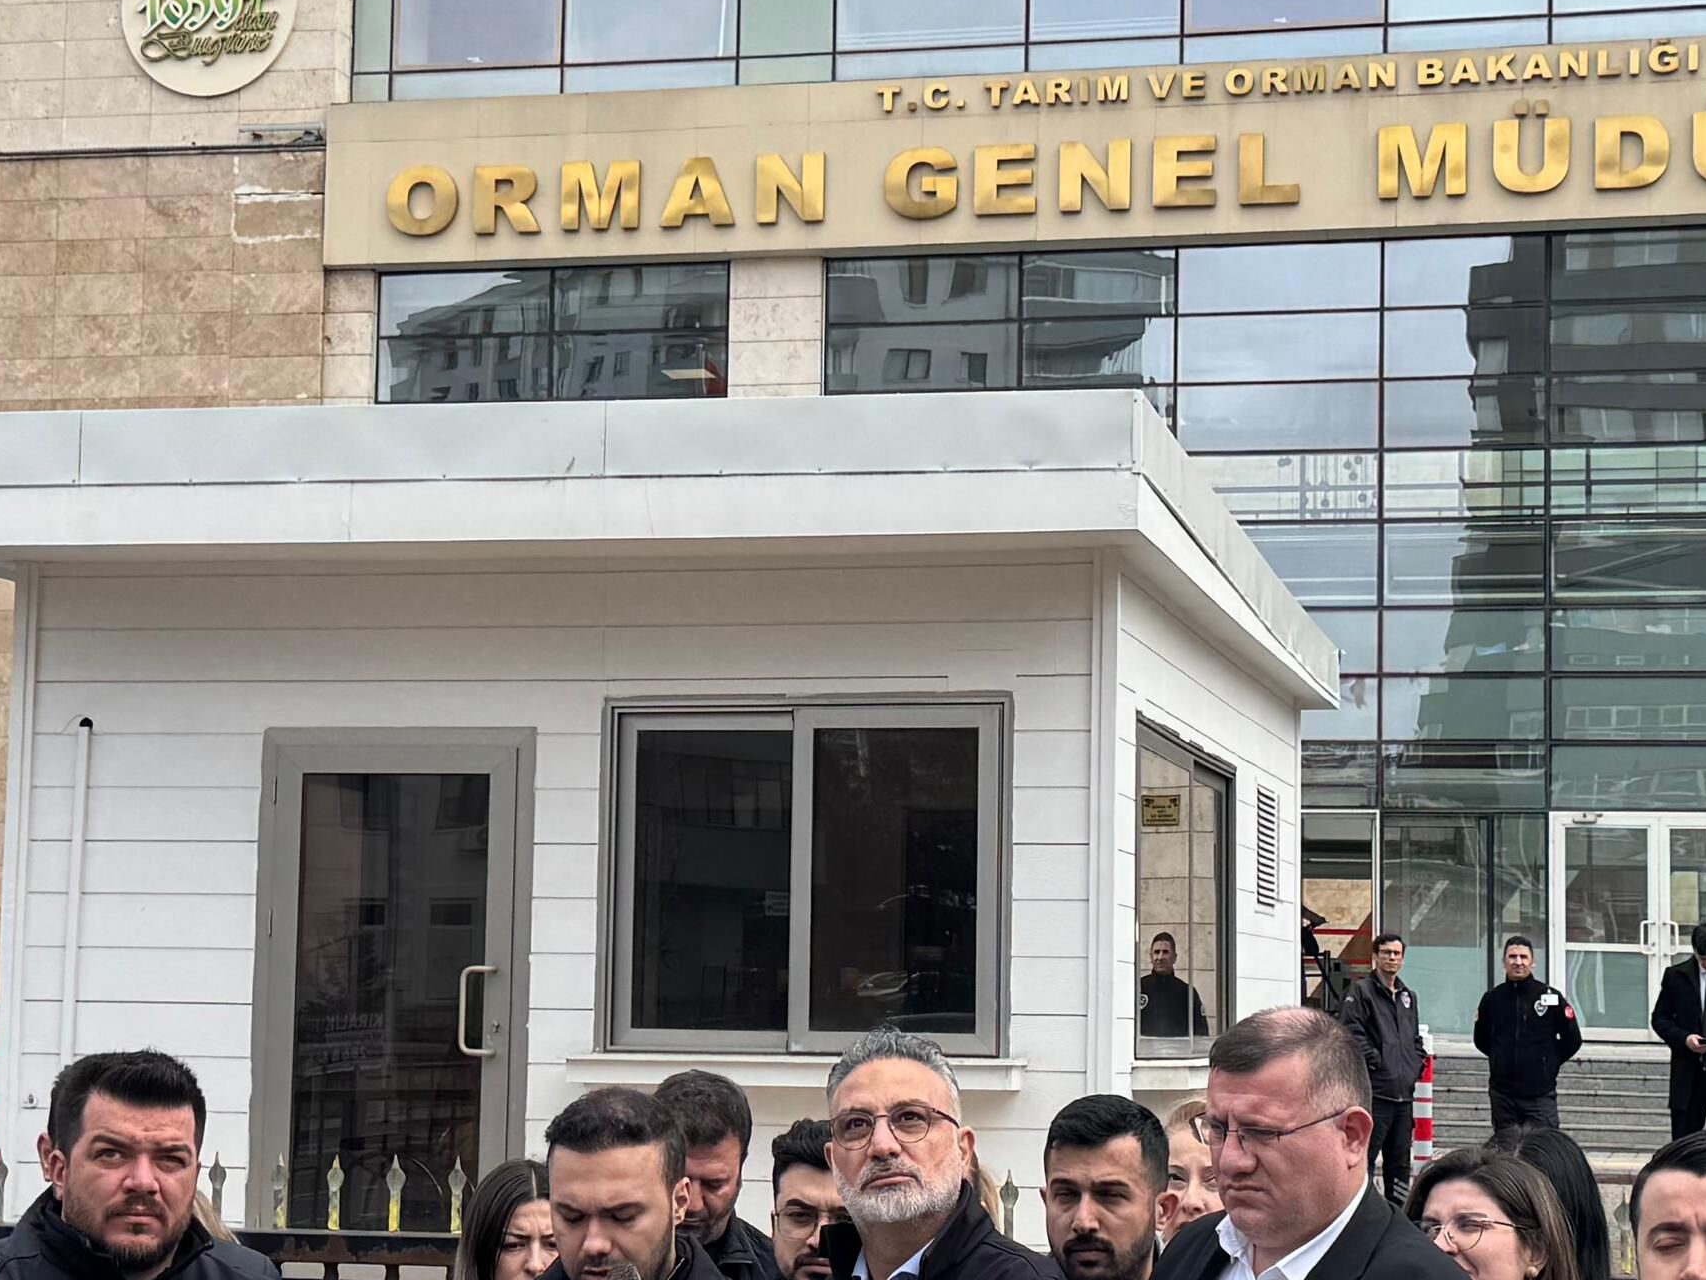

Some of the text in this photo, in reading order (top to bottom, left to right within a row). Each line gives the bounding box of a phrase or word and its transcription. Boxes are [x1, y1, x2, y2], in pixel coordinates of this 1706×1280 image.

[876, 38, 1700, 113] T.C. TARIM VE ORMAN BAKANLIĞI
[384, 150, 827, 238] ORMAN
[881, 132, 1300, 221] GENEL
